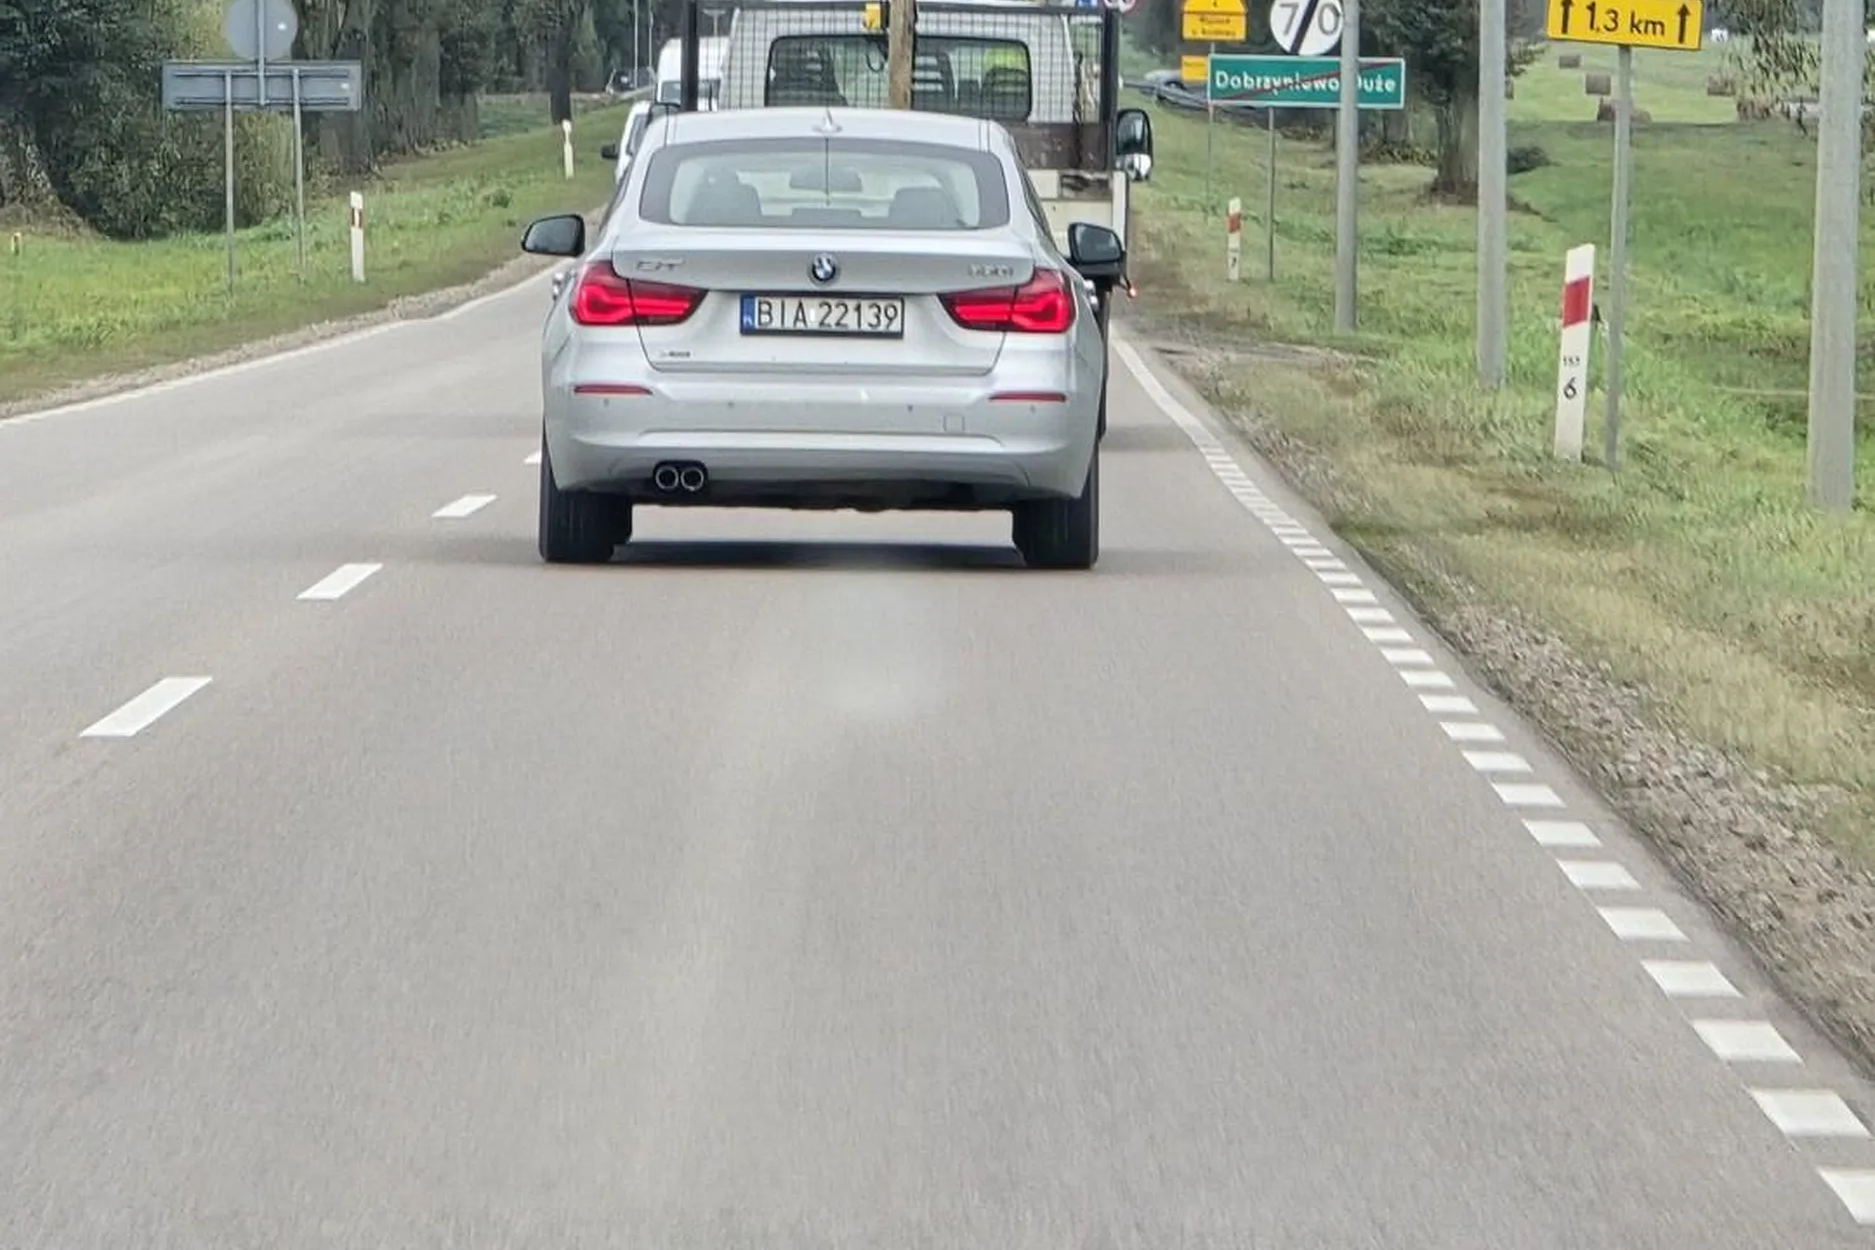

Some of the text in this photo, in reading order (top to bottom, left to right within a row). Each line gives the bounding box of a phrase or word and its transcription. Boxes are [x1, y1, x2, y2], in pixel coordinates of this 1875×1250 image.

[1280, 2, 1340, 36] 70
[1629, 10, 1666, 36] km
[1356, 73, 1397, 93] uże
[757, 300, 899, 330] BIA 22139
[1563, 376, 1577, 400] 6
